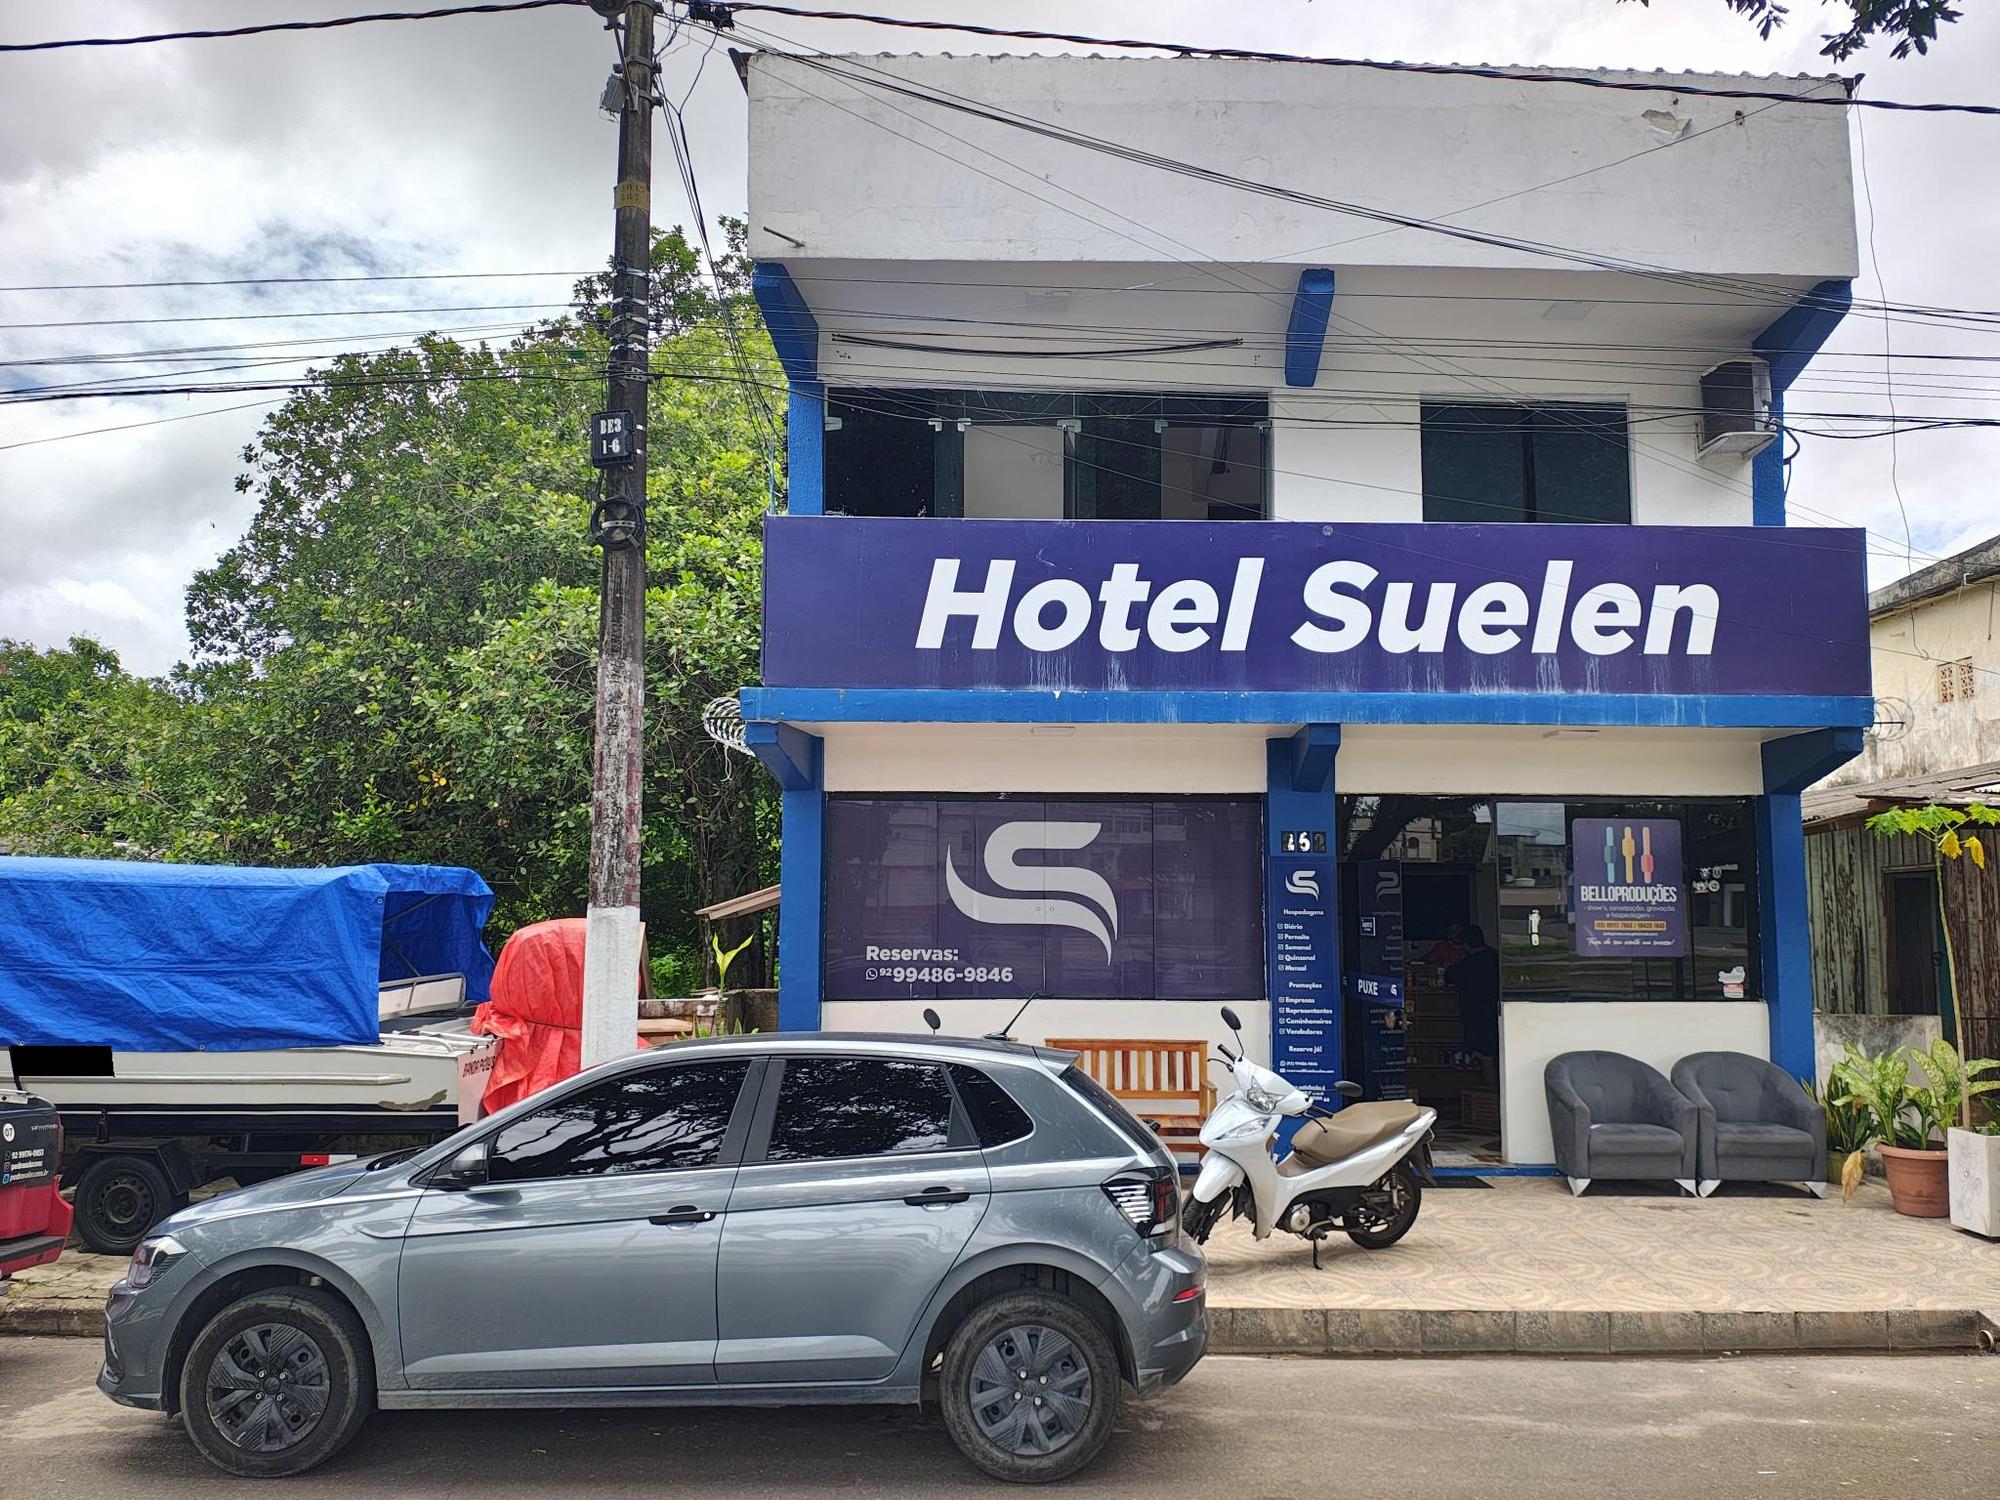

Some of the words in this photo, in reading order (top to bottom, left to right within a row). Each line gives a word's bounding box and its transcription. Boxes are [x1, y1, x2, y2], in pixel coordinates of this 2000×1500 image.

[600, 418, 622, 435] BE3
[602, 438, 620, 455] 1-6
[916, 557, 1265, 651] Hotel
[1290, 559, 1720, 655] Suelen
[1580, 883, 1678, 906] BELLOPRODUÇÕES
[1283, 908, 1324, 917] Hospedagens
[866, 945, 959, 961] Reservas:
[1285, 954, 1316, 962] Quinzenal
[892, 966, 1014, 983] 99486-9846
[1288, 981, 1322, 990] Promoções
[1358, 978, 1379, 996] PUXE
[1285, 996, 1315, 1005] Empresas
[1285, 1007, 1333, 1015] Representantes
[1286, 1017, 1333, 1025] Caminhoneiros
[1286, 1027, 1323, 1035] Vendedores
[5, 1127, 13, 1138] 07
